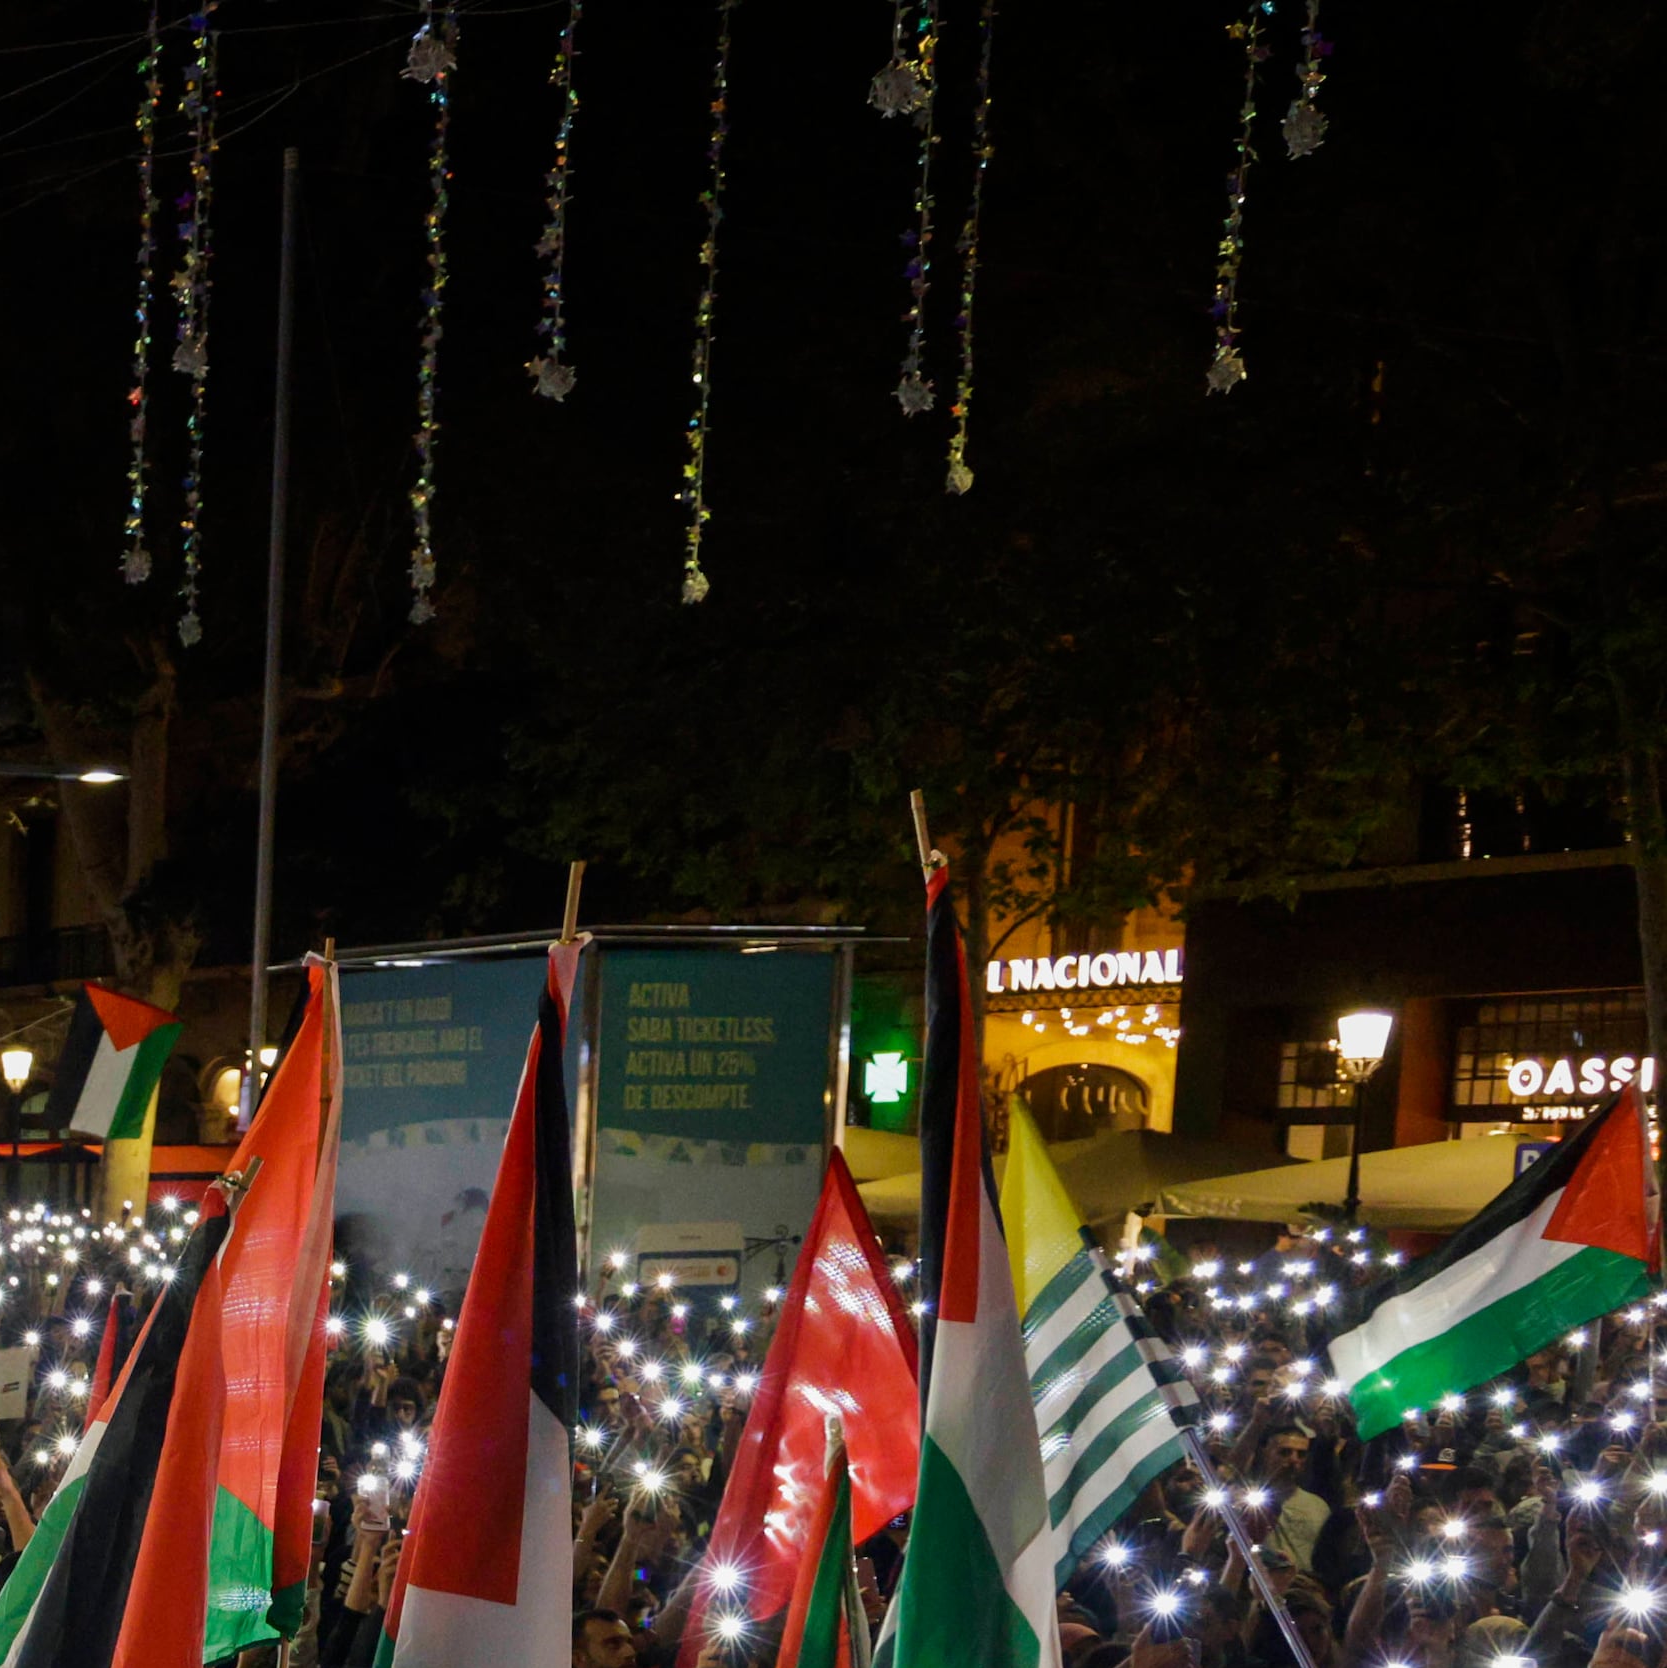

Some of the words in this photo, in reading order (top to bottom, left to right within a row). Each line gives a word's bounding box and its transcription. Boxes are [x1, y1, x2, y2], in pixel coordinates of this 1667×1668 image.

[986, 961, 1004, 992] L
[1010, 949, 1184, 990] NACIONAL
[626, 982, 690, 1008] ACTIVA
